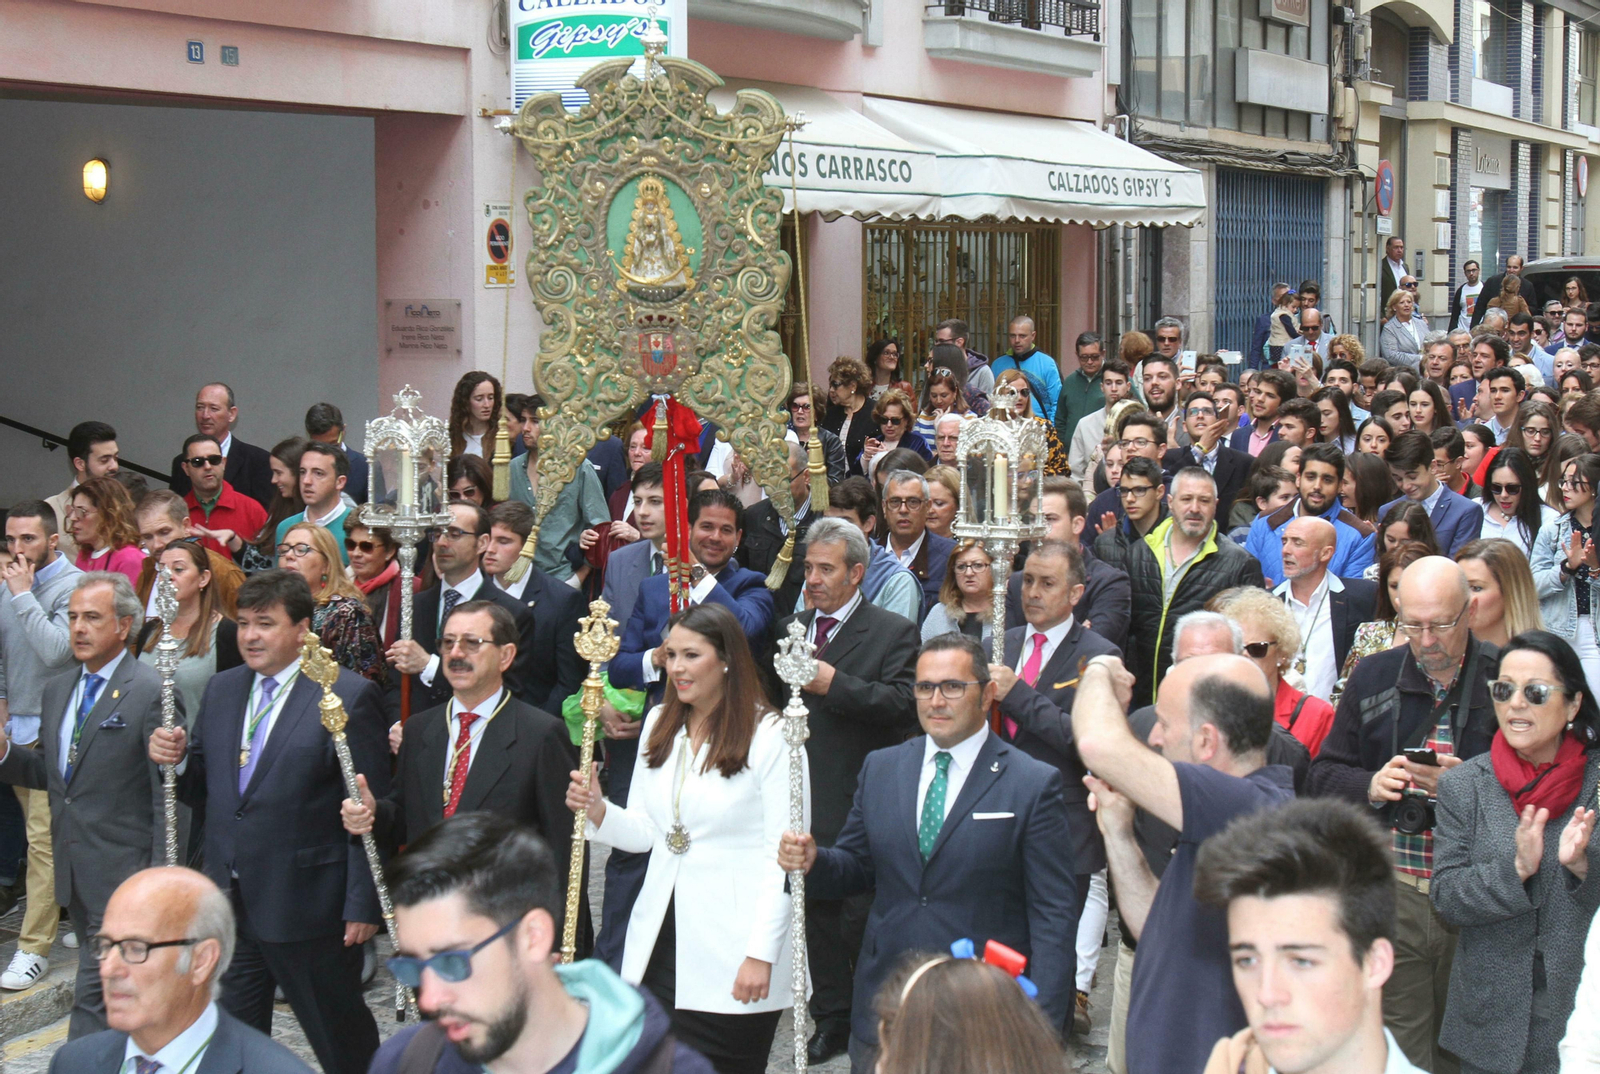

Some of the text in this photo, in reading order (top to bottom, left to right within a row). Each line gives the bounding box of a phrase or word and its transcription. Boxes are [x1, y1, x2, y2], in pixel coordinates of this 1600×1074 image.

[530, 18, 650, 59] Gipsy's
[191, 45, 201, 60] 13
[225, 48, 236, 63] 15
[815, 153, 913, 183] CARRASCO
[1048, 171, 1119, 196] CALZADOS
[391, 324, 415, 332] Eduardo
[420, 342, 433, 350] Rico
